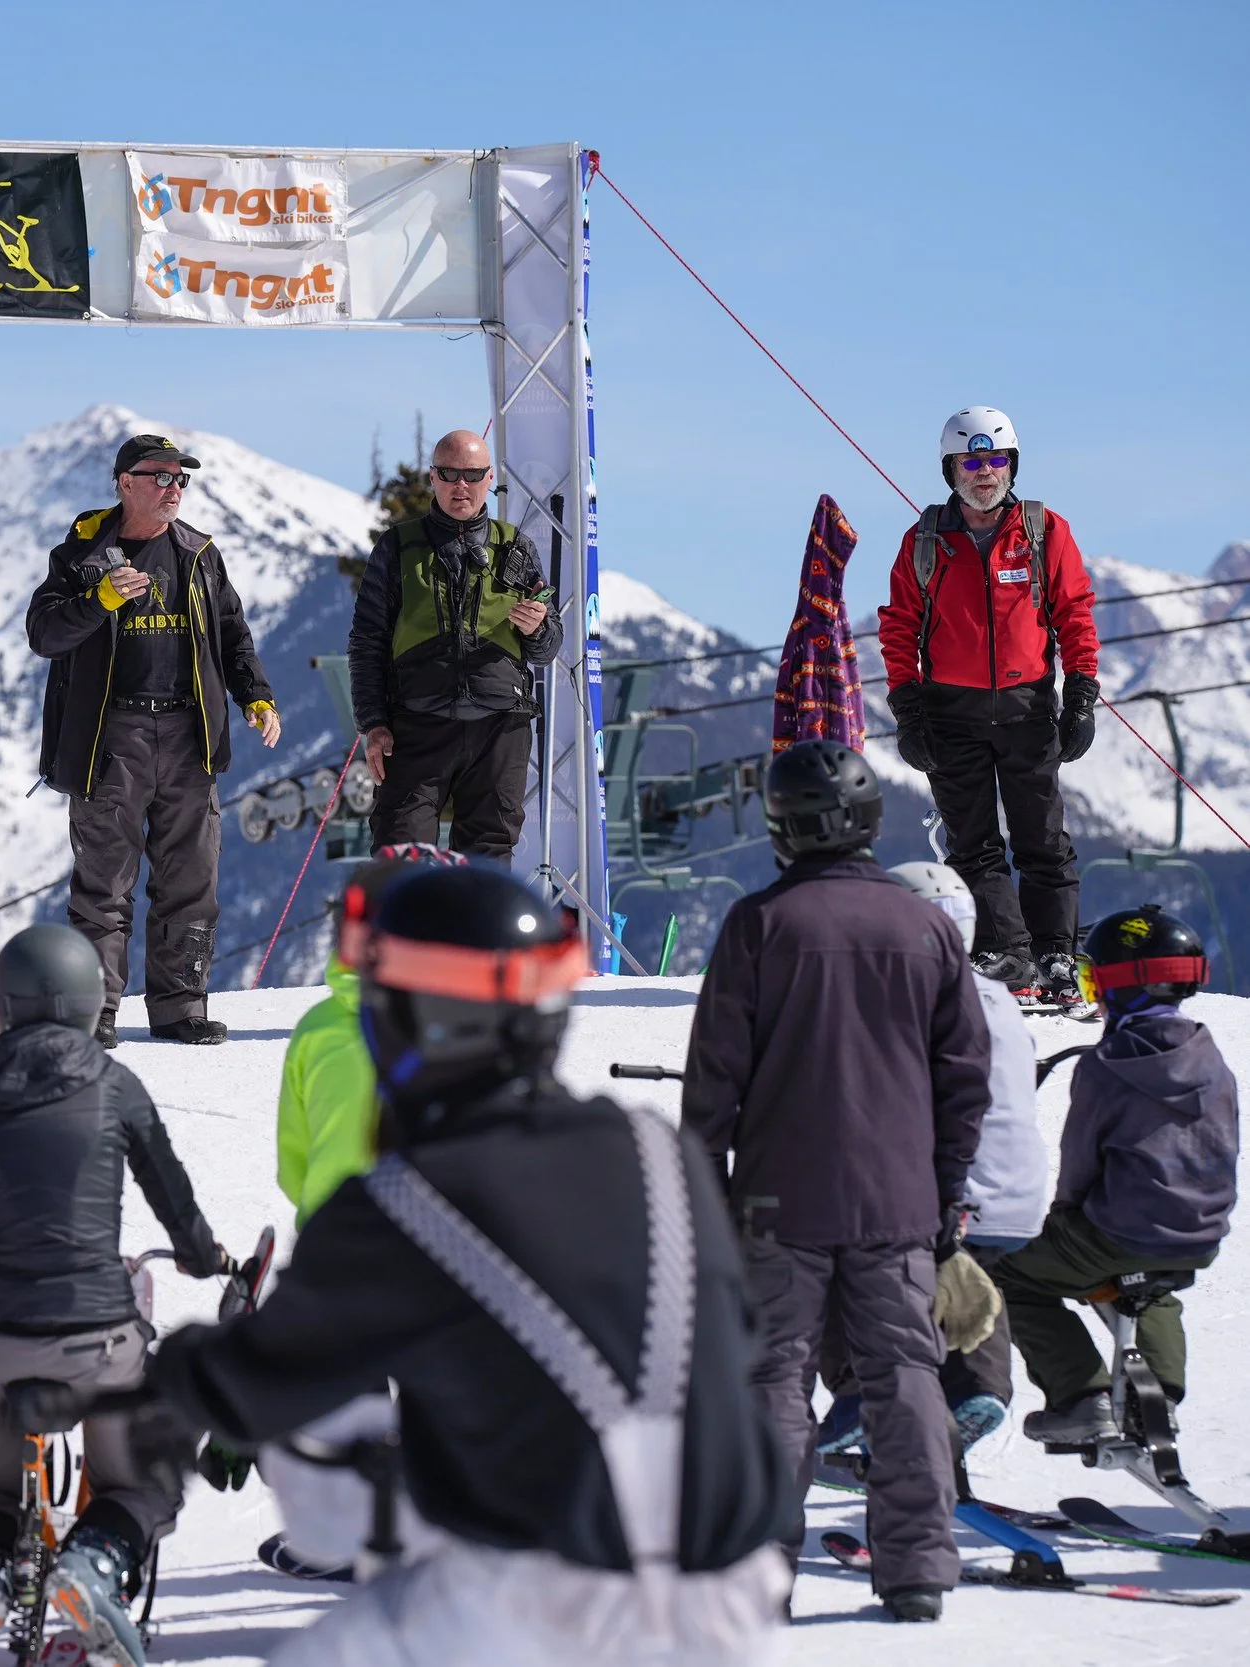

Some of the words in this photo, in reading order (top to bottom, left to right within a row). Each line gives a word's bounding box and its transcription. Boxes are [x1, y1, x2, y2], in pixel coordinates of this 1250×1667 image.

[168, 177, 333, 226] Tngnt
[273, 214, 293, 225] ski
[297, 214, 333, 224] bikes
[179, 257, 334, 310] Tngnt
